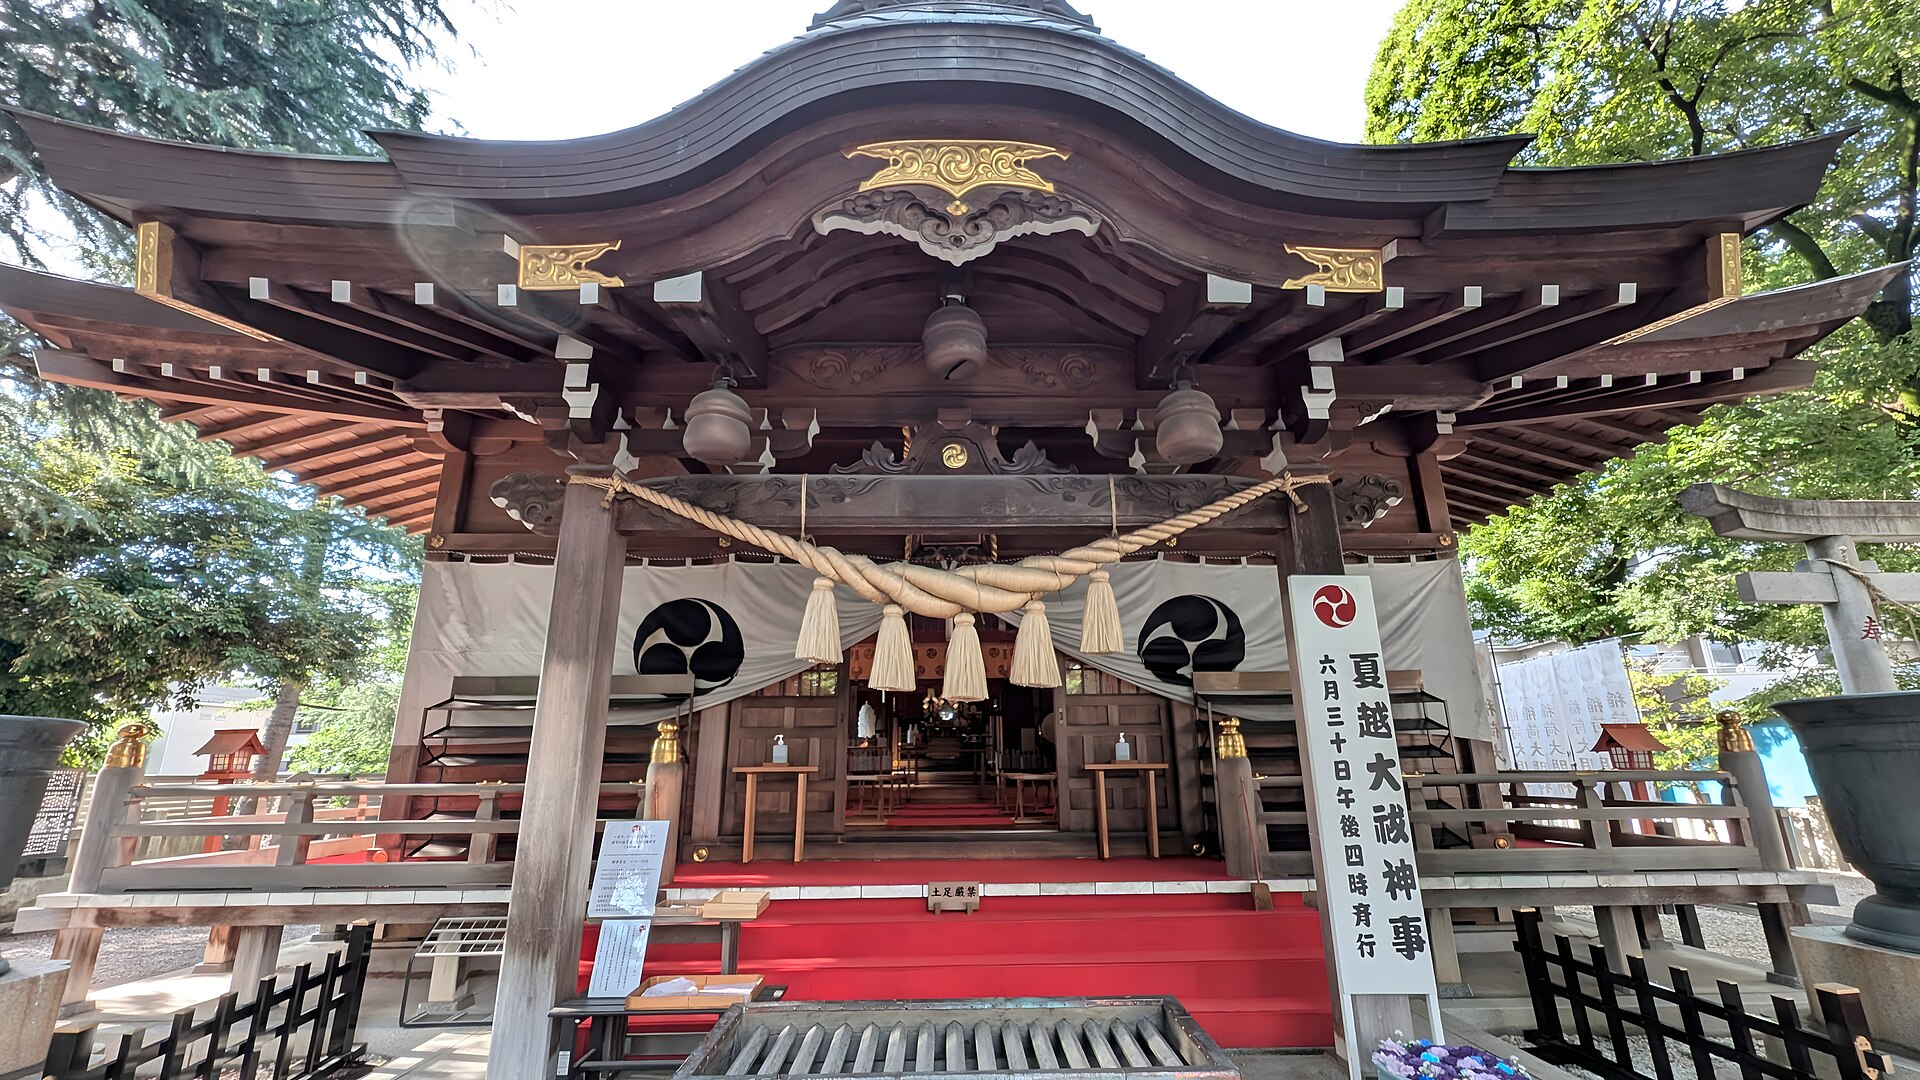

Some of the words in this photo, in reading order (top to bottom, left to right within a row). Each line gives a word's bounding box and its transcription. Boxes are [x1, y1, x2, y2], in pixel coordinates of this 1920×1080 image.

[1349, 653, 1427, 961] 夏越大祓神事
[931, 886, 976, 898] 土足厳禁
